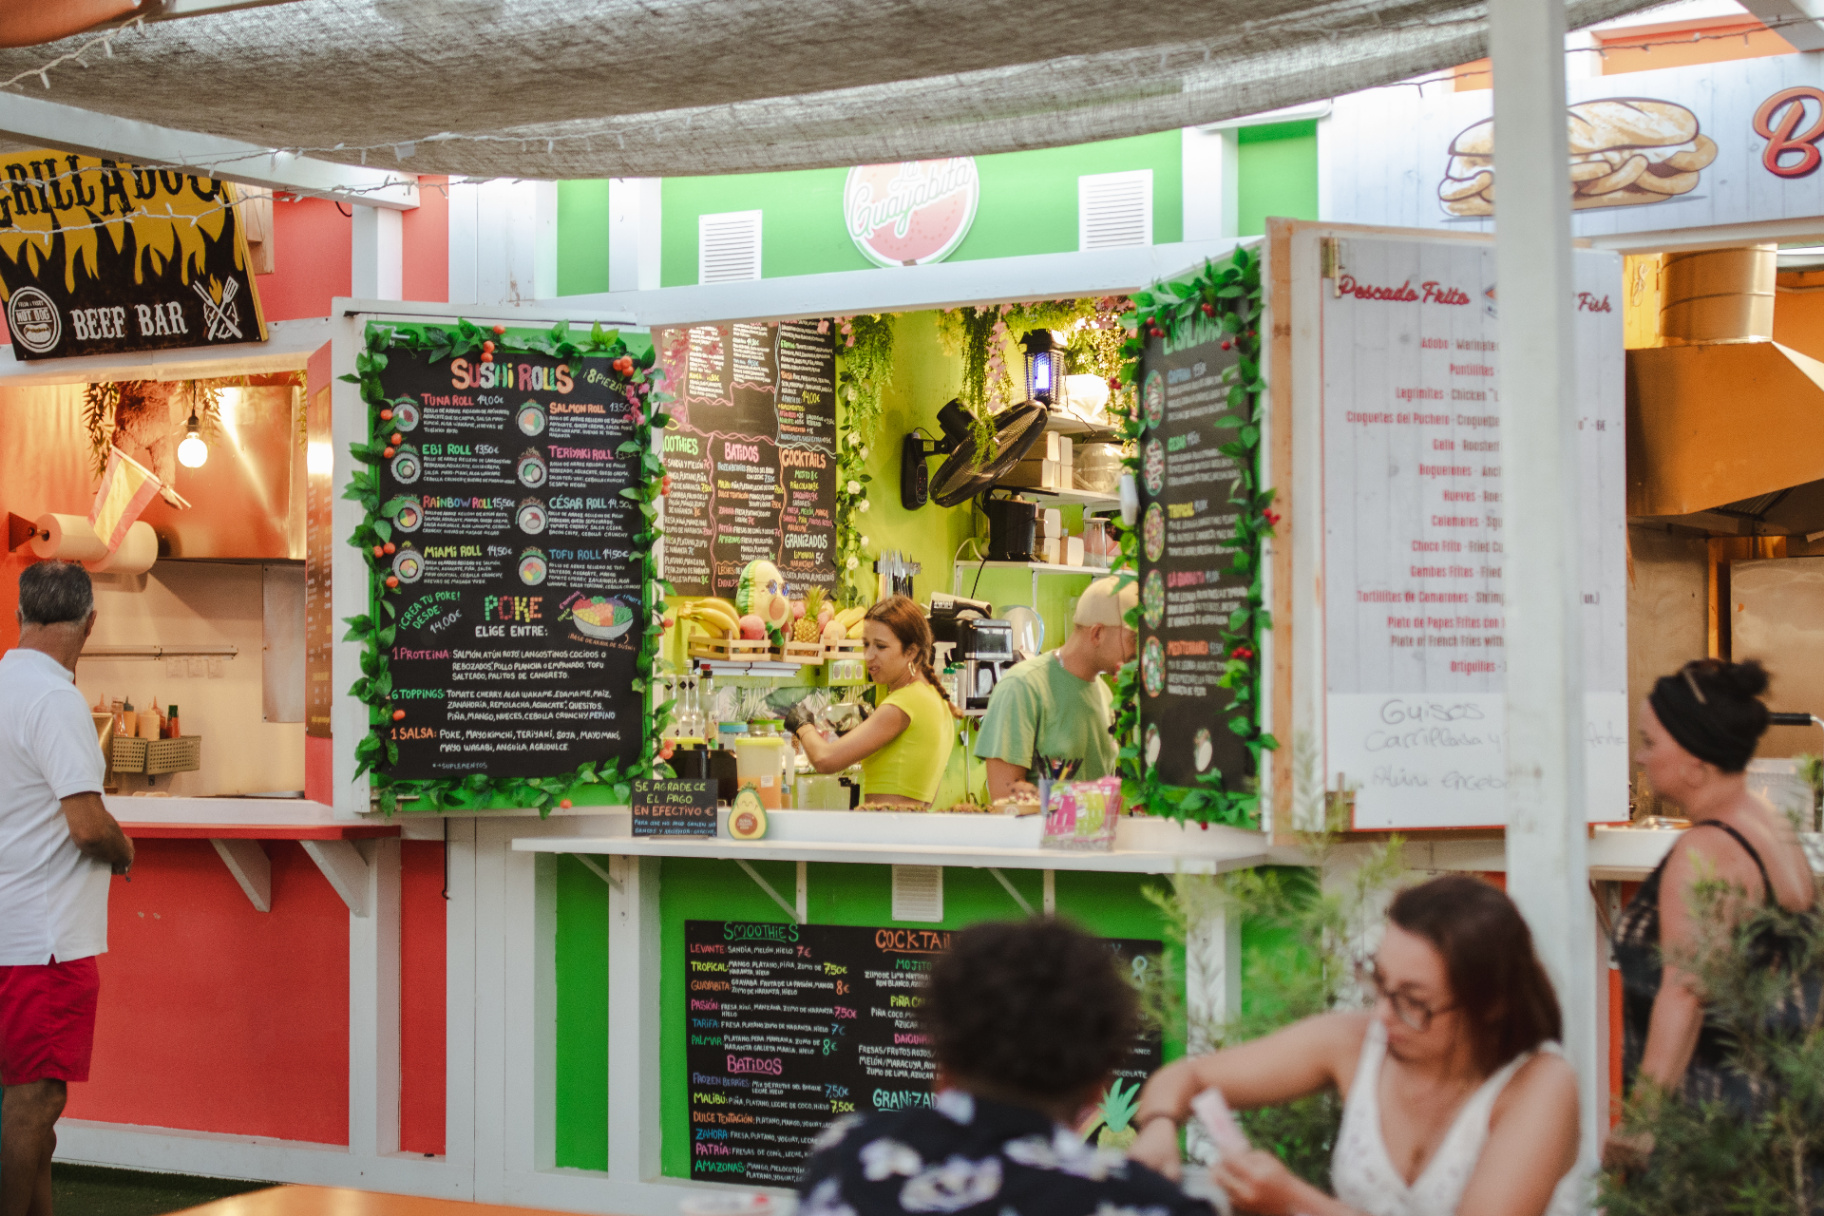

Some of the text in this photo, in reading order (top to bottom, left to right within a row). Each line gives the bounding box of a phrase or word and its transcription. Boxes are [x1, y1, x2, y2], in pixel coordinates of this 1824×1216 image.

[1340, 274, 1419, 302] Pescado
[1421, 281, 1471, 305] Frito
[70, 301, 188, 341] BEEF BAR
[1420, 337, 1448, 349] Adobo
[451, 357, 574, 394] SUSHi ROLLS
[421, 393, 451, 406] TUNA
[452, 394, 474, 406] ROLL
[549, 401, 606, 415] SALMON ROLL
[1346, 411, 1450, 427] Croquetas del Puchero
[447, 443, 472, 455] ROLL
[592, 449, 614, 460] ROLL
[725, 442, 759, 463] BATiDOS
[781, 449, 827, 469] COCKTAiLS
[422, 495, 471, 509] RAiNBOW
[472, 496, 493, 509] ROLL
[549, 494, 607, 510] CÉSAR ROLL
[1431, 515, 1479, 527] Calamares
[784, 533, 828, 549] GRANiZADOS
[1411, 540, 1439, 552] Choco
[1441, 540, 1462, 552] Frito
[460, 545, 482, 557] ROLL
[549, 549, 573, 560] TOFU
[577, 549, 601, 560] ROLL
[1410, 565, 1447, 578] Gambas
[1450, 565, 1474, 578] Fritas
[420, 593, 433, 605] TU
[435, 591, 460, 602] POKE!
[484, 595, 543, 623] POKE
[1413, 617, 1424, 629] de
[1483, 618, 1499, 629] con
[475, 625, 548, 638] ELiGE ENTRE:
[483, 650, 501, 659] ATÚN
[493, 661, 604, 671] POLLO PLANCHA TOFU
[391, 689, 399, 700] 6
[446, 689, 475, 698] TOMATE
[503, 690, 520, 698] ALGA
[524, 712, 554, 720] CEBOLLA
[1380, 698, 1485, 725] Guisos
[390, 728, 397, 740] 1
[400, 727, 437, 740] SALSA:
[440, 729, 464, 741] POKE,
[440, 744, 461, 753] MAYO
[635, 781, 706, 793] SE AGRADECE
[646, 793, 693, 804] EL PAGO
[634, 805, 649, 816] EN
[652, 805, 702, 816] EFECTiVO
[724, 921, 799, 942] SMOOTHiES
[891, 995, 910, 1007] PiÑA
[727, 1054, 782, 1075] BATiDOS
[692, 1072, 721, 1084] FROZEN
[830, 1099, 855, 1114] 7,50€
[693, 1111, 715, 1123] DULCE
[732, 1146, 755, 1156] FRESAS
